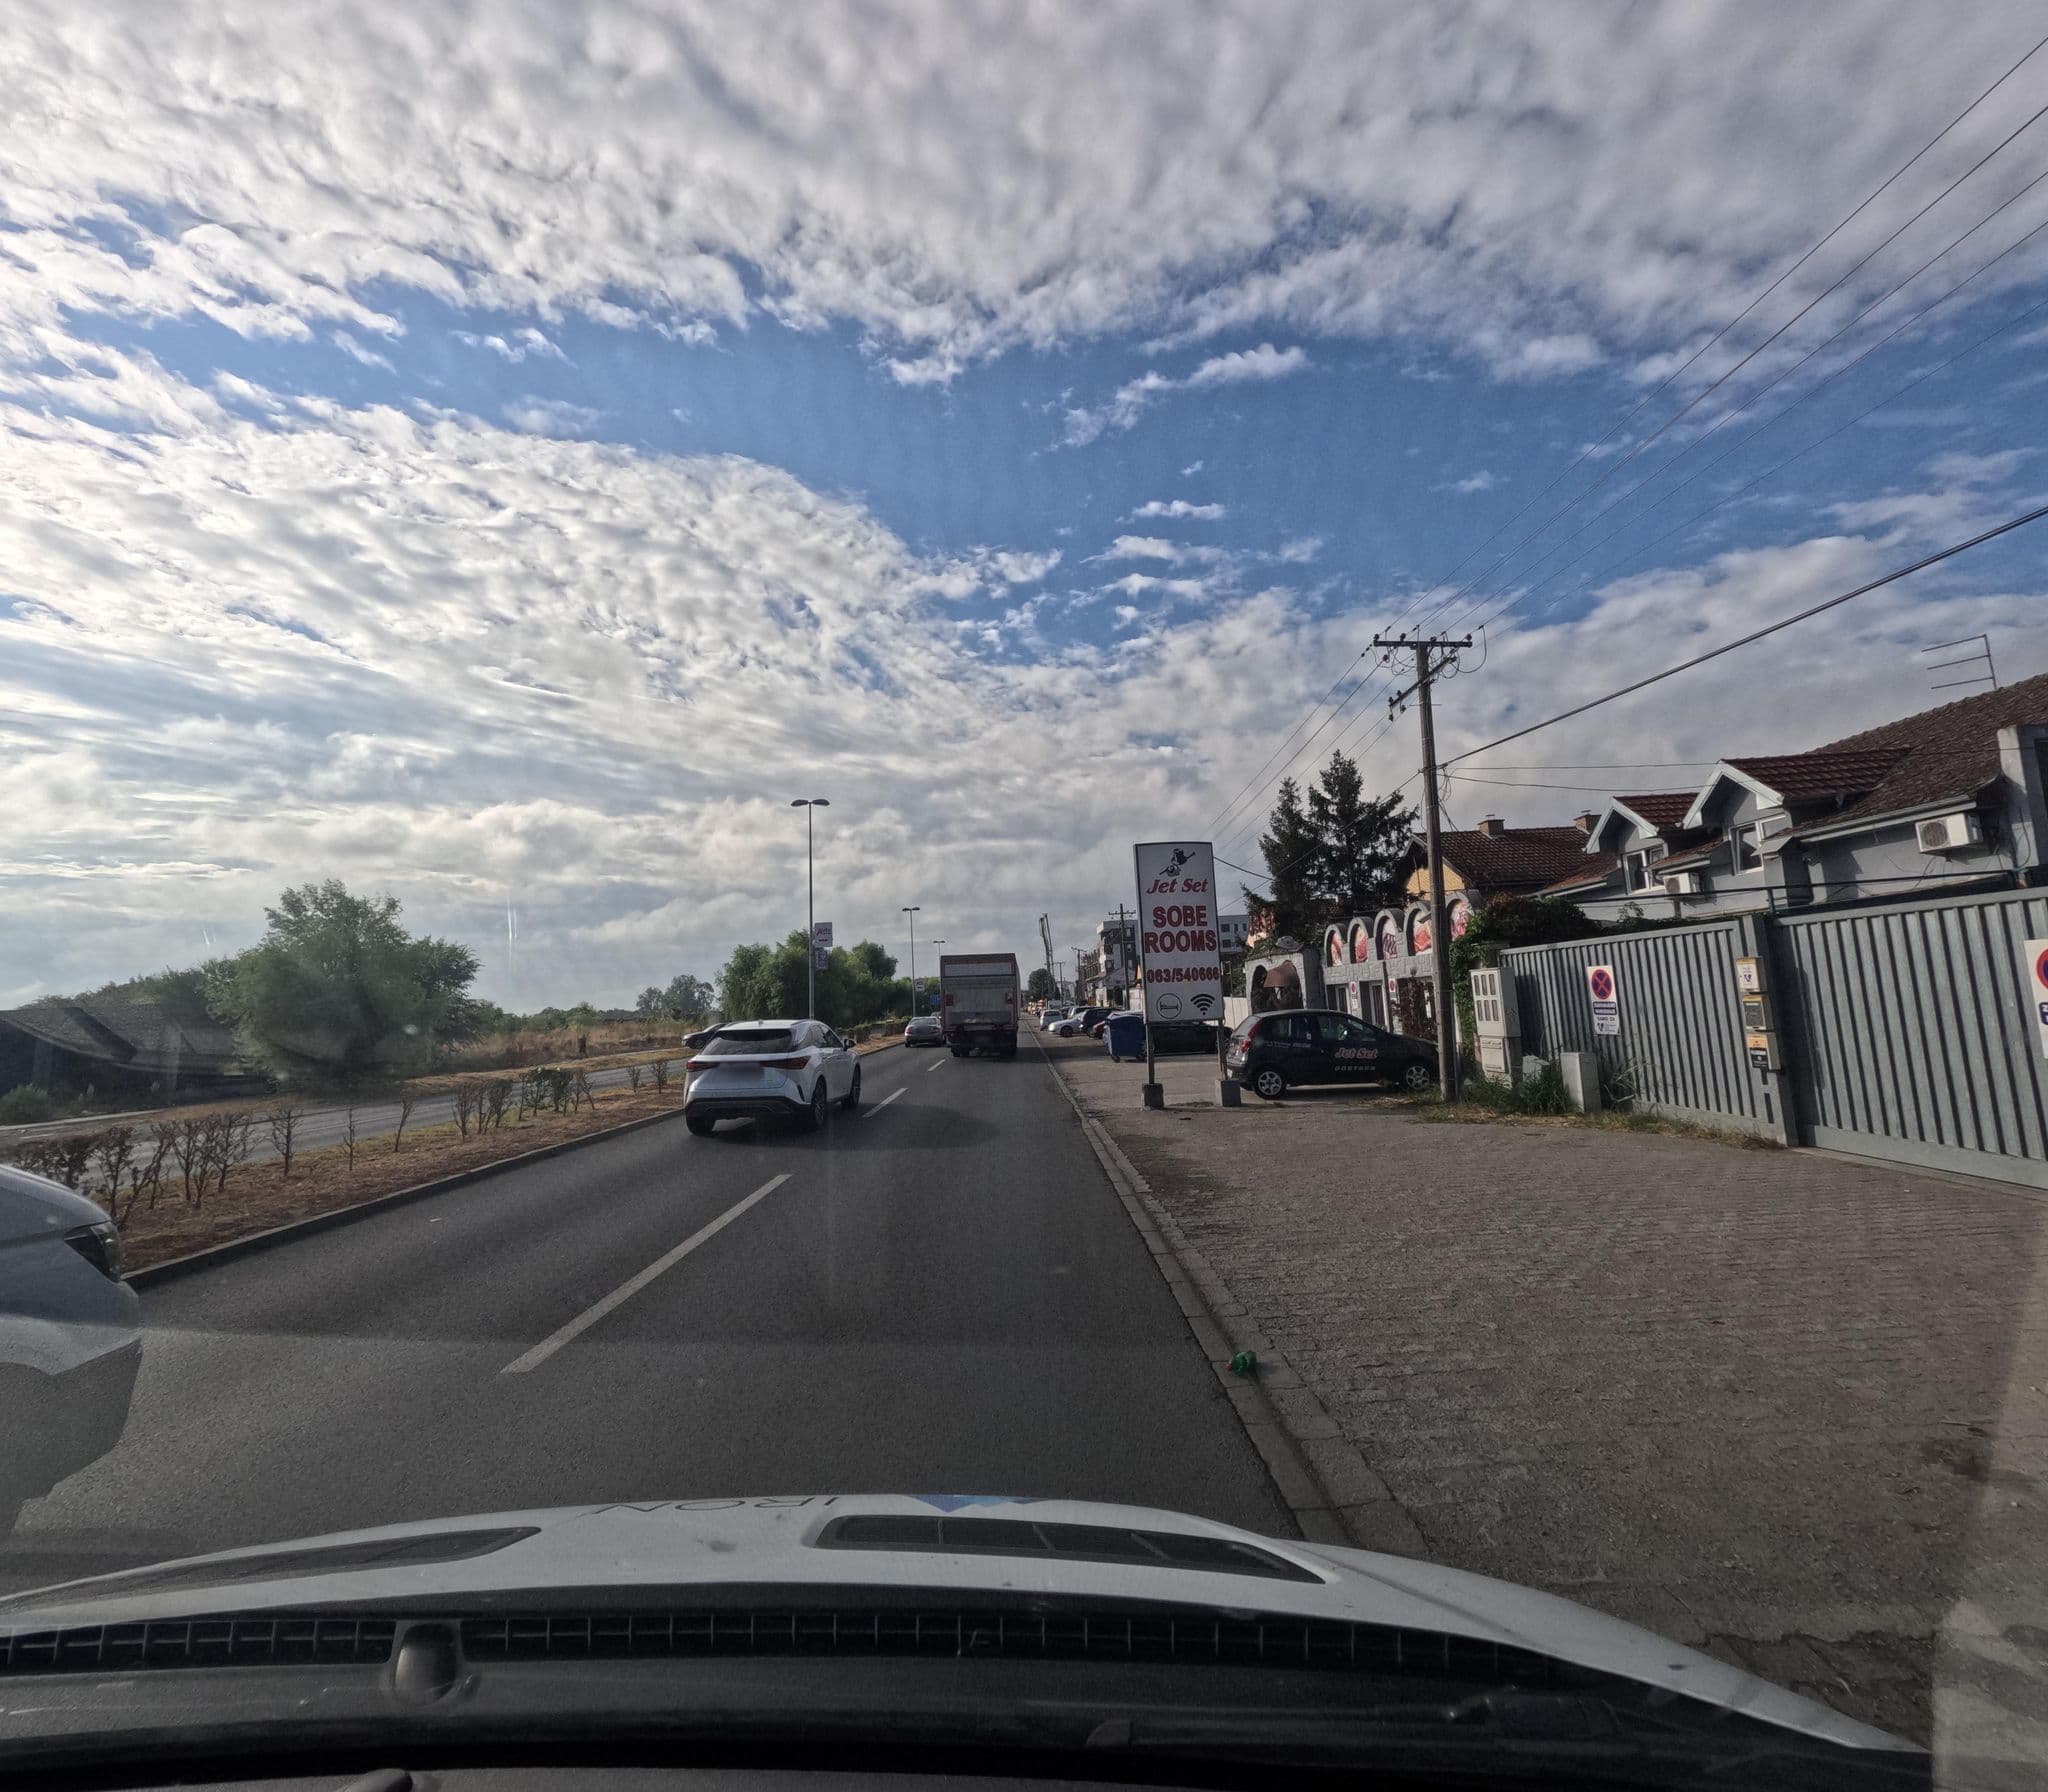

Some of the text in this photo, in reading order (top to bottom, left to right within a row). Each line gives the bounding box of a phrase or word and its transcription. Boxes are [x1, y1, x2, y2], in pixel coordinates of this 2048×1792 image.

[1147, 878, 1208, 894] Jet Set
[1153, 905, 1208, 928] SOBE
[1144, 930, 1217, 953] ROOMS
[1147, 967, 1219, 983] 063/540666
[592, 1497, 838, 1514] IRON
